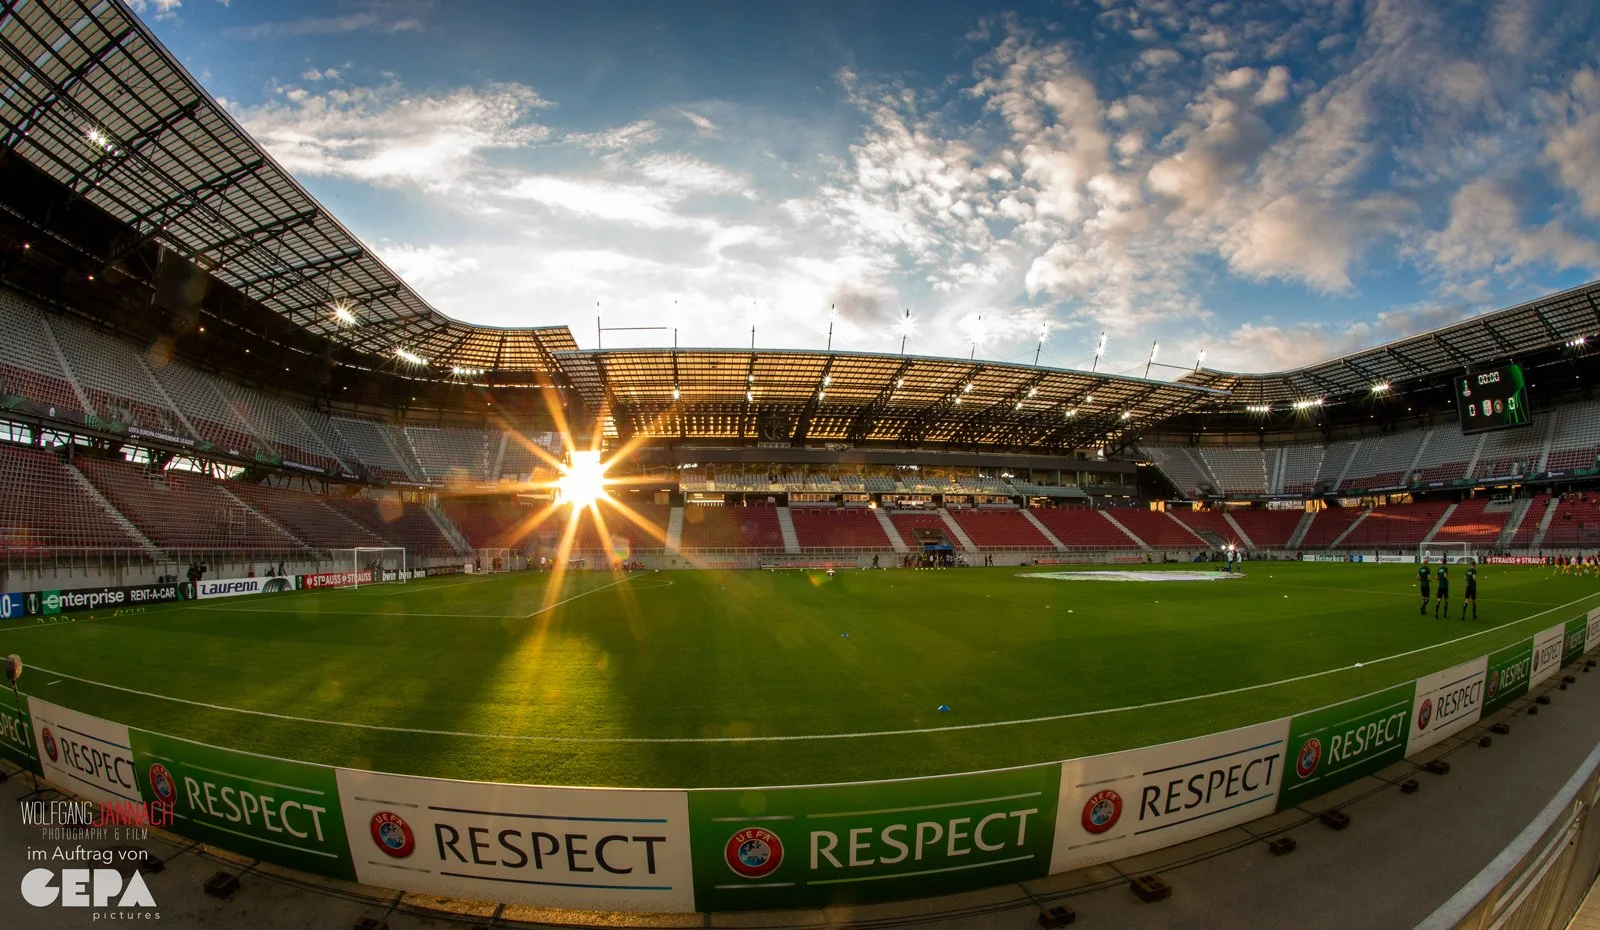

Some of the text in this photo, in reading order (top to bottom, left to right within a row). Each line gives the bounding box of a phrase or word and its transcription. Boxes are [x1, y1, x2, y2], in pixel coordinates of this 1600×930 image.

[1478, 371, 1500, 385] 00:00
[1469, 404, 1476, 417] 0
[1508, 397, 1515, 410] 0
[1315, 554, 1344, 562] Heineken
[382, 569, 397, 582] bwin
[414, 567, 426, 579] bwin
[47, 584, 176, 609] enterprise RENT-A-CAR
[1540, 640, 1562, 664] RESPECT
[1500, 657, 1531, 688] RESPECT
[1436, 680, 1483, 721] RESPECT
[1328, 711, 1407, 765] RESPECT
[60, 737, 141, 792] RESPECT
[1090, 791, 1118, 804] UEFA
[1139, 753, 1280, 820] RESPECT
[184, 776, 326, 841] RESPECT
[375, 813, 403, 827] UEFA
[735, 830, 772, 843] UEFA
[810, 807, 1039, 870] RESPECT
[434, 823, 667, 875] RESPECT
